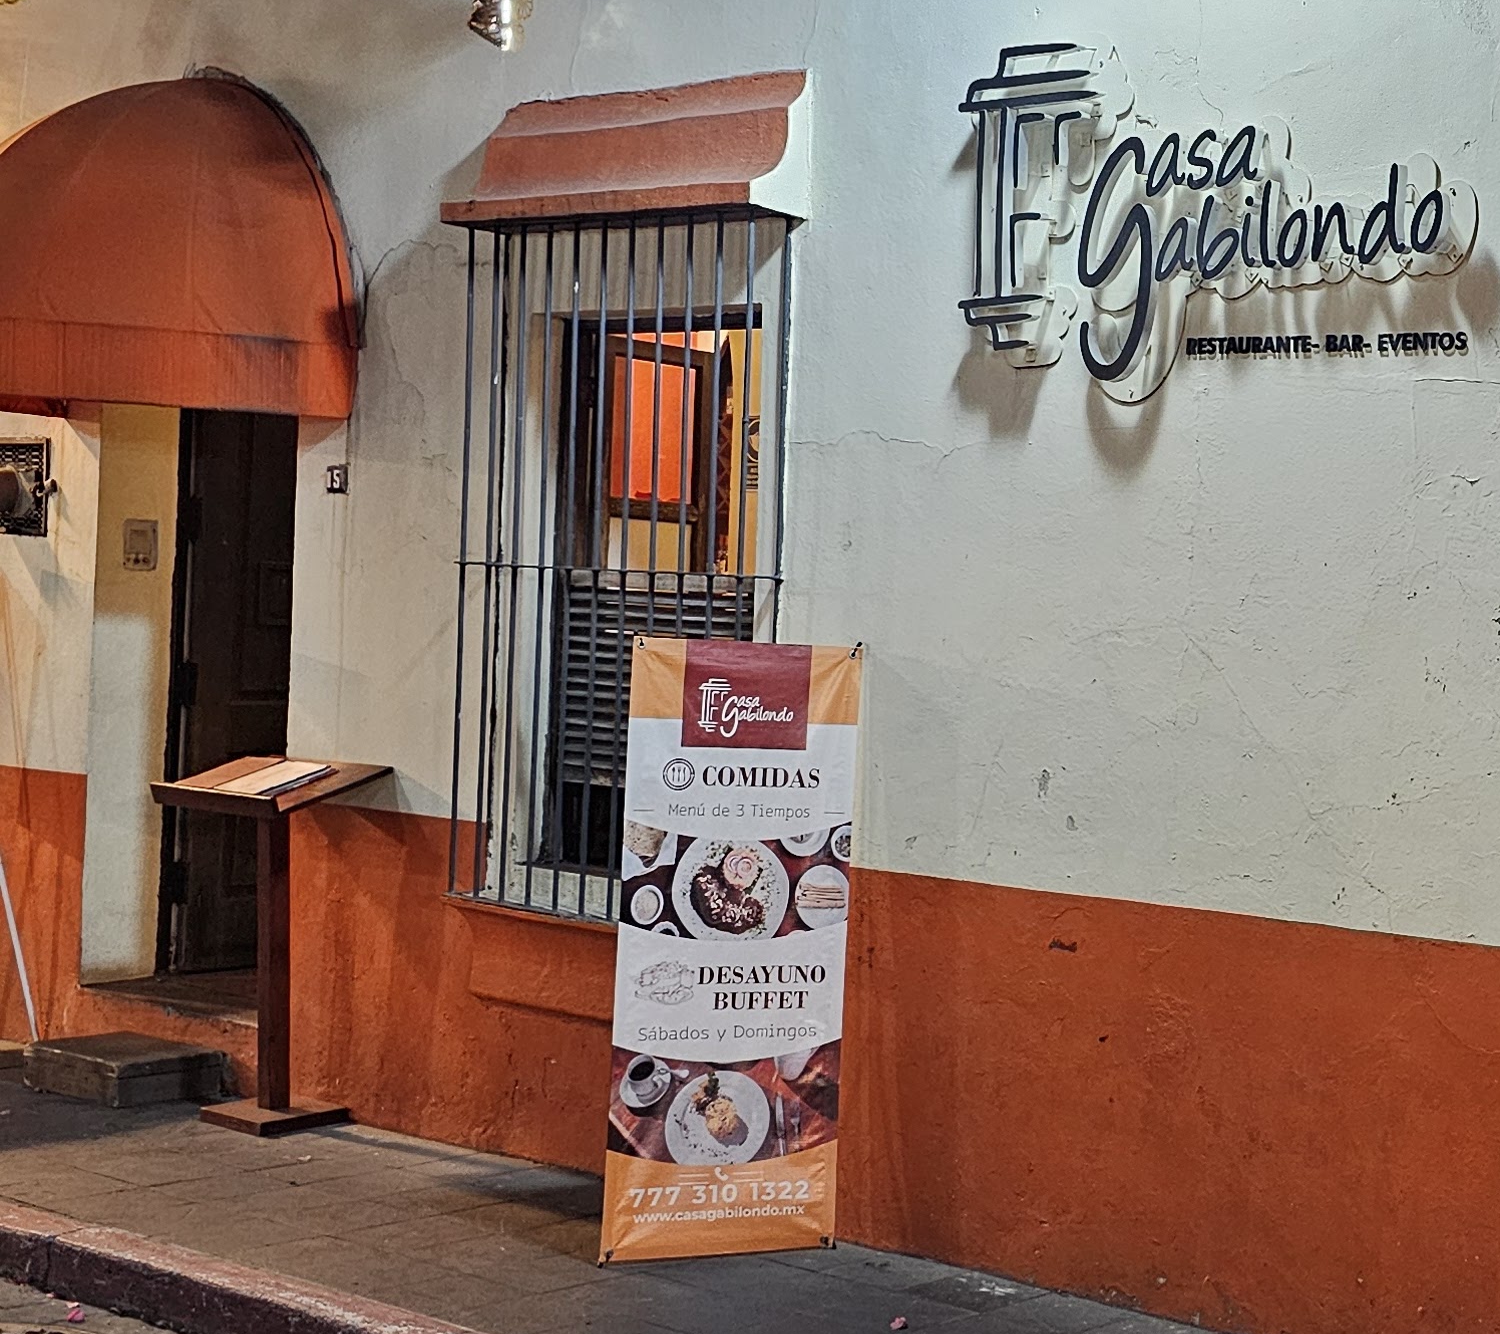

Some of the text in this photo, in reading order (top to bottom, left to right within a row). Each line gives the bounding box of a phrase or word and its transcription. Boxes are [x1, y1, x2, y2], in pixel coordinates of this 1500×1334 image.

[1185, 331, 1469, 356] RESTAURANTE- BAR- EVENTOS
[702, 765, 821, 789] COMIDAS
[668, 802, 811, 821] Menú de 3 Tiempos
[696, 964, 826, 985] DESAYUNO
[712, 990, 809, 1011] BUFFET
[637, 1023, 817, 1043] Sábados y Domingos
[630, 1179, 810, 1208] 777 310 1322
[632, 1203, 805, 1225] www.casagabilondo.mx
